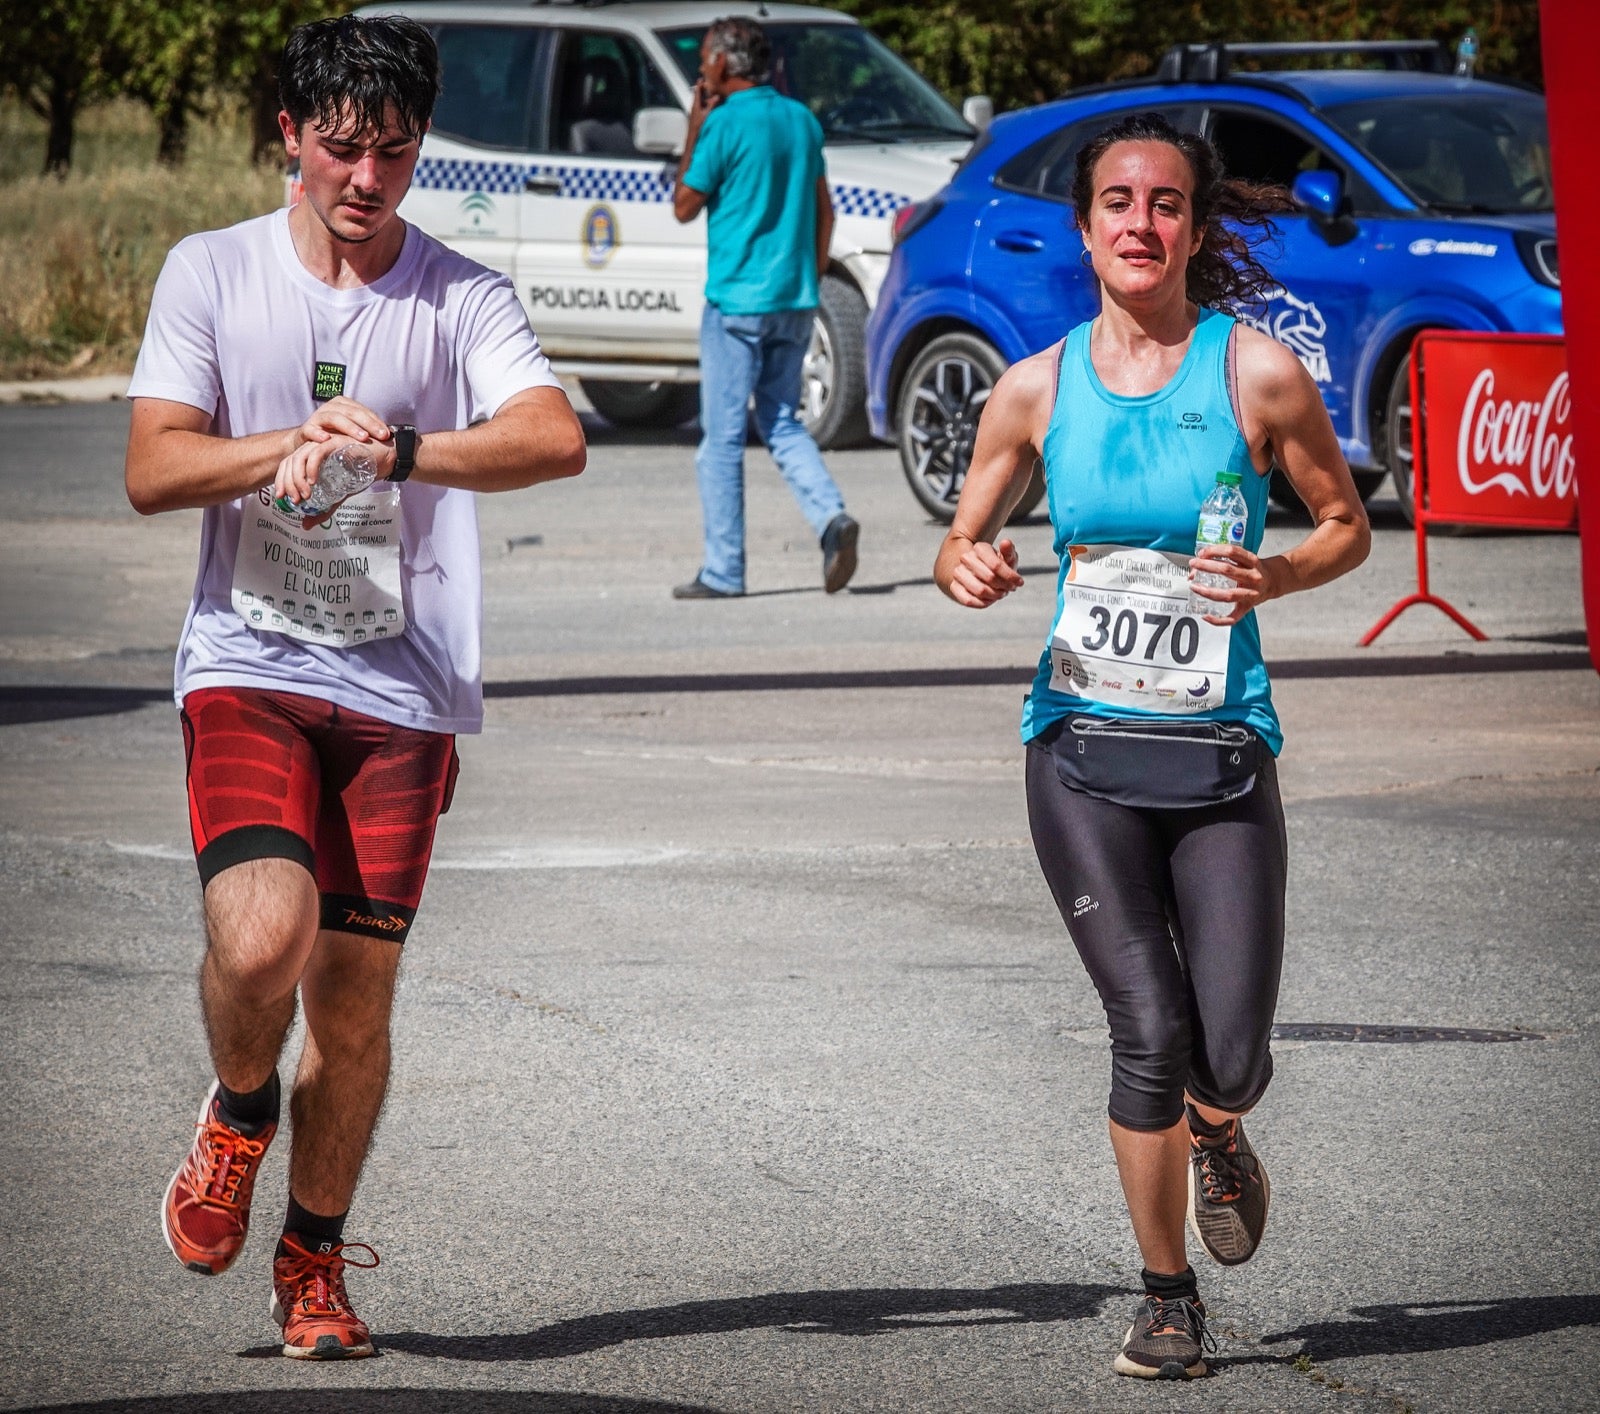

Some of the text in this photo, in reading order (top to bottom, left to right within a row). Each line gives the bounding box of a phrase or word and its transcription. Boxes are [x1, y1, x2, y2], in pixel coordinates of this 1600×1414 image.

[530, 286, 682, 313] POLICIA LOCAL
[318, 364, 343, 374] your
[257, 518, 273, 530] GRAN
[300, 538, 321, 549] FONDO
[358, 535, 387, 546] GRANADA
[361, 519, 368, 527] el
[368, 518, 393, 526] cáncer
[264, 541, 370, 580] YO CORRO CONTRA
[1105, 558, 1124, 569] GRAN
[284, 571, 351, 604] EL CÁNCER
[1153, 577, 1172, 589] LORCA
[1081, 605, 1200, 665] 3070
